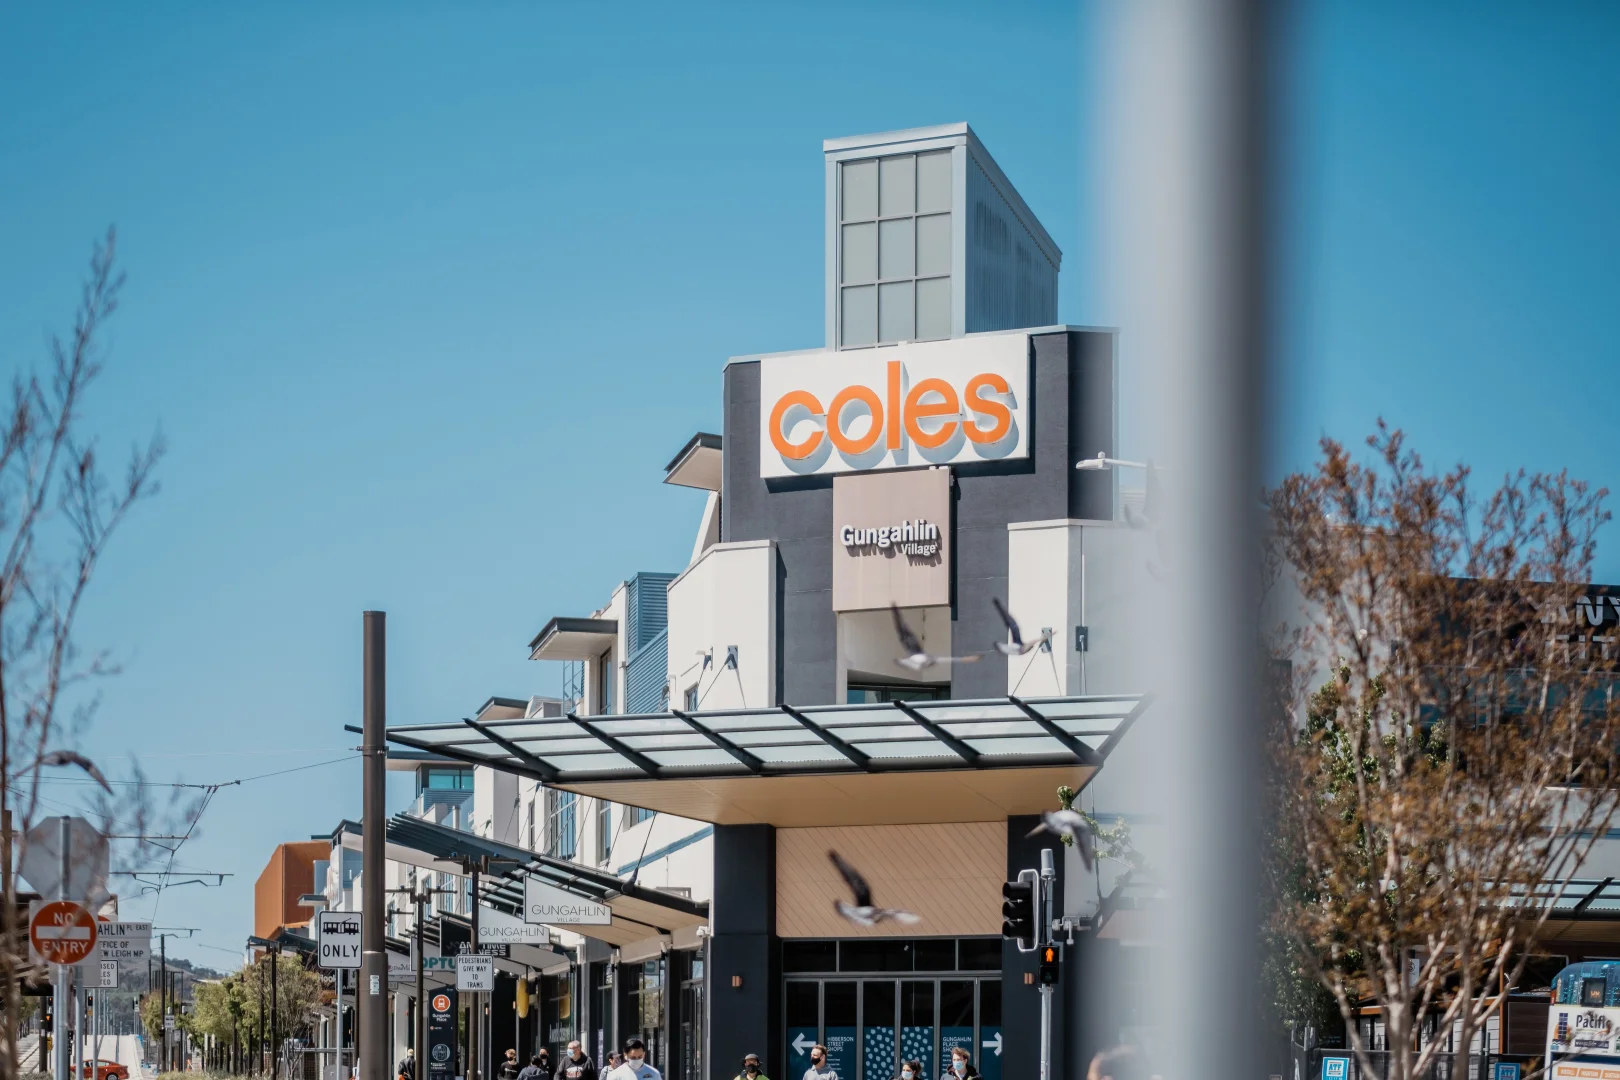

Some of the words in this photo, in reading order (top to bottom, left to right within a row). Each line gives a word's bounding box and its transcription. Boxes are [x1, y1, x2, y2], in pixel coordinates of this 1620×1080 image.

[769, 360, 1012, 460] coles
[840, 519, 937, 548] Gungahlin
[900, 542, 937, 556] Village
[531, 904, 606, 917] GUNGAHLIN
[53, 912, 75, 924] NO
[479, 926, 545, 937] GUNGAHLIN
[42, 941, 88, 955] ENTRY
[322, 944, 359, 957] ONLY
